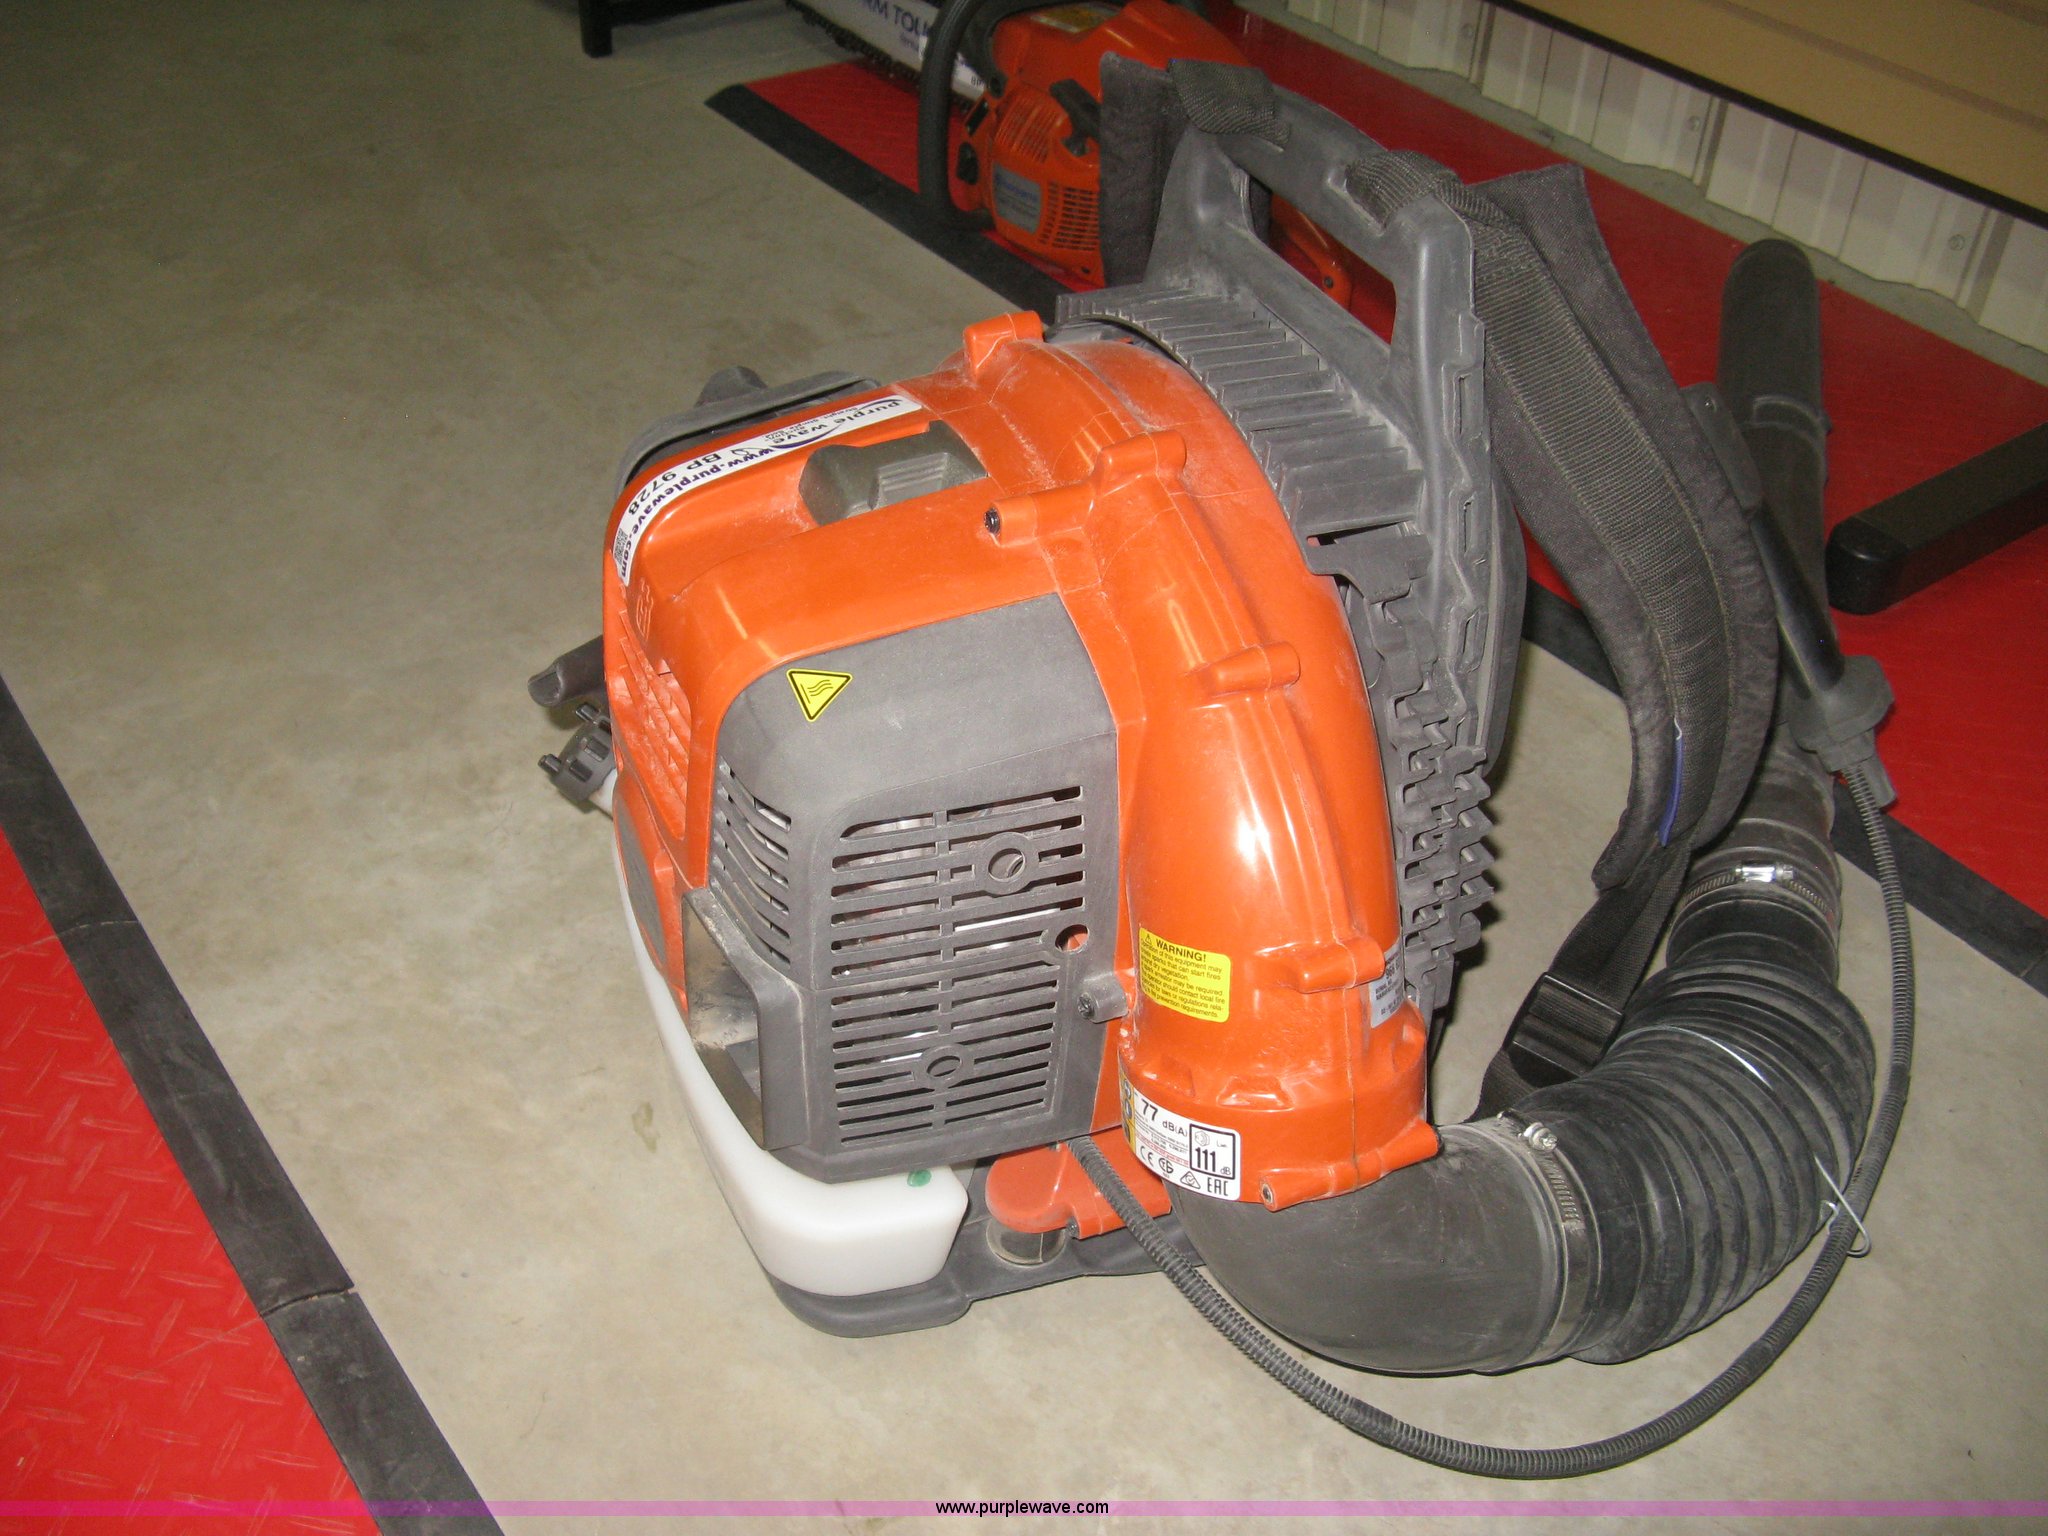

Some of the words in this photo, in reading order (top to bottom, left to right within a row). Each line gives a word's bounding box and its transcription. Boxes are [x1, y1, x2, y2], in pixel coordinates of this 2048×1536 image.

[834, 401, 900, 424] purple
[773, 425, 829, 444] wave
[686, 453, 723, 470] BP
[628, 471, 677, 516] 9728
[621, 448, 774, 577] www.purplewave.com
[1155, 939, 1207, 962] WARNING!
[1174, 958, 1207, 971] equipment
[1207, 966, 1222, 974] may
[1190, 969, 1205, 977] start
[1206, 972, 1221, 981] fires
[1186, 982, 1195, 990] be
[1195, 985, 1223, 996] required
[1200, 994, 1214, 1002] local
[1215, 996, 1225, 1004] fire
[1141, 1098, 1158, 1121] 77
[1162, 1120, 1188, 1138] dB(A)
[1195, 1146, 1216, 1173] 111
[1220, 1166, 1231, 1176] dB
[1207, 1177, 1229, 1197] EAC
